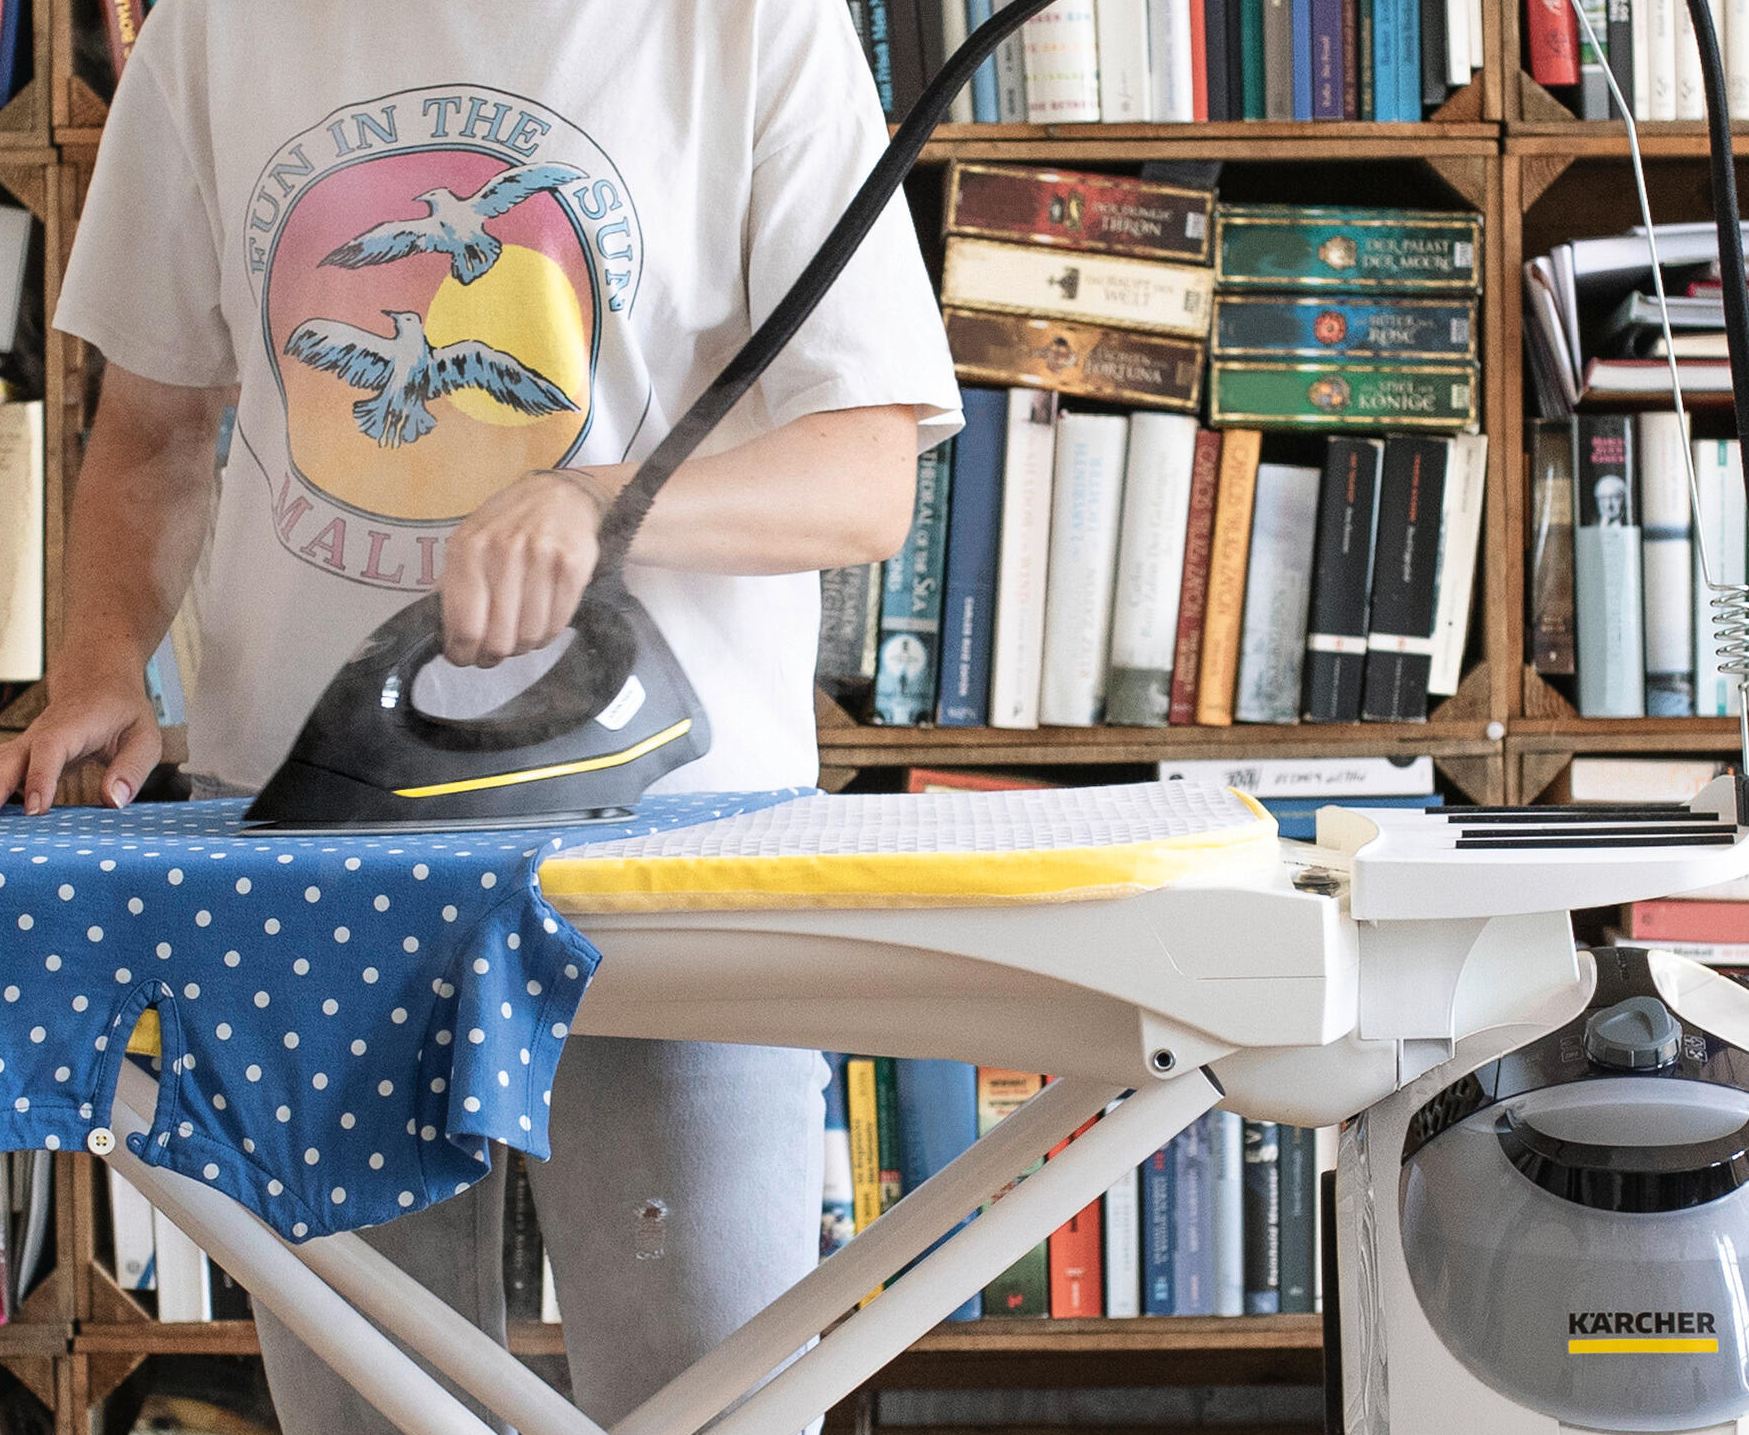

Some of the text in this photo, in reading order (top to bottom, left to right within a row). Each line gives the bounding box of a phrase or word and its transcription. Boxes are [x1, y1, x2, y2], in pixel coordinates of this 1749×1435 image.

[249, 95, 634, 314] FUN IN THE SUN
[915, 450, 938, 526] THEDRAL
[274, 473, 451, 586] MALI
[912, 578, 937, 611] SEA
[1569, 1310, 1717, 1335] KÄRCHER
